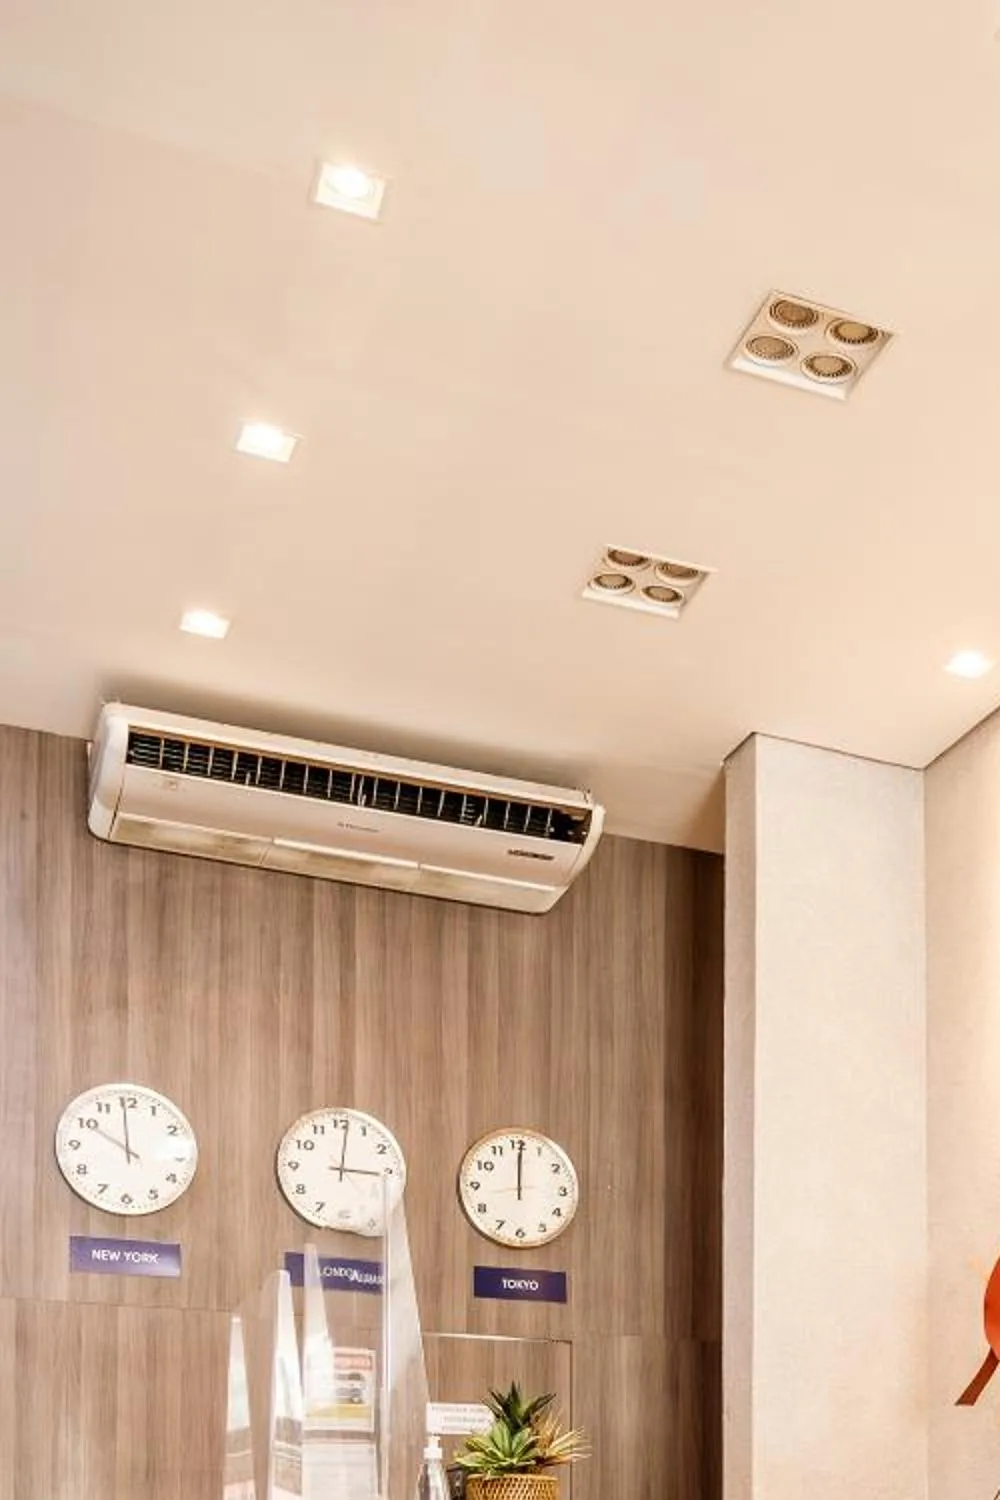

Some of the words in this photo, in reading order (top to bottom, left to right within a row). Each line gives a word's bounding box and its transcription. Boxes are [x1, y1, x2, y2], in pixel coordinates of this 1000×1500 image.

[96, 1102, 111, 1115] 11
[150, 1104, 157, 1117] 1
[78, 1117, 99, 1130] 10
[313, 1124, 326, 1135] 11
[167, 1124, 179, 1136] 2
[361, 1126, 367, 1137] 1
[68, 1139, 81, 1151] 9
[296, 1139, 315, 1151] 10
[376, 1143, 388, 1155] 2
[491, 1145, 504, 1156] 11
[510, 1139, 527, 1151] 12
[76, 1163, 88, 1175] 8
[287, 1161, 300, 1172] 9
[476, 1159, 495, 1171] 10
[551, 1163, 561, 1174] 2
[165, 1173, 177, 1184] 4
[97, 1183, 109, 1195] 7
[295, 1183, 306, 1195] 8
[469, 1181, 480, 1192] 9
[559, 1186, 568, 1197] 3
[120, 1193, 133, 1205] 6
[148, 1189, 159, 1201] 5
[315, 1201, 326, 1213] 7
[477, 1203, 487, 1214] 8
[551, 1207, 562, 1217] 4
[495, 1219, 506, 1230] 7
[537, 1223, 547, 1233] 5
[515, 1228, 526, 1239] 6
[90, 1248, 121, 1262] NEW
[123, 1250, 160, 1265] YORK
[316, 1265, 357, 1279] LONDO
[501, 1277, 539, 1291] TOKYO
